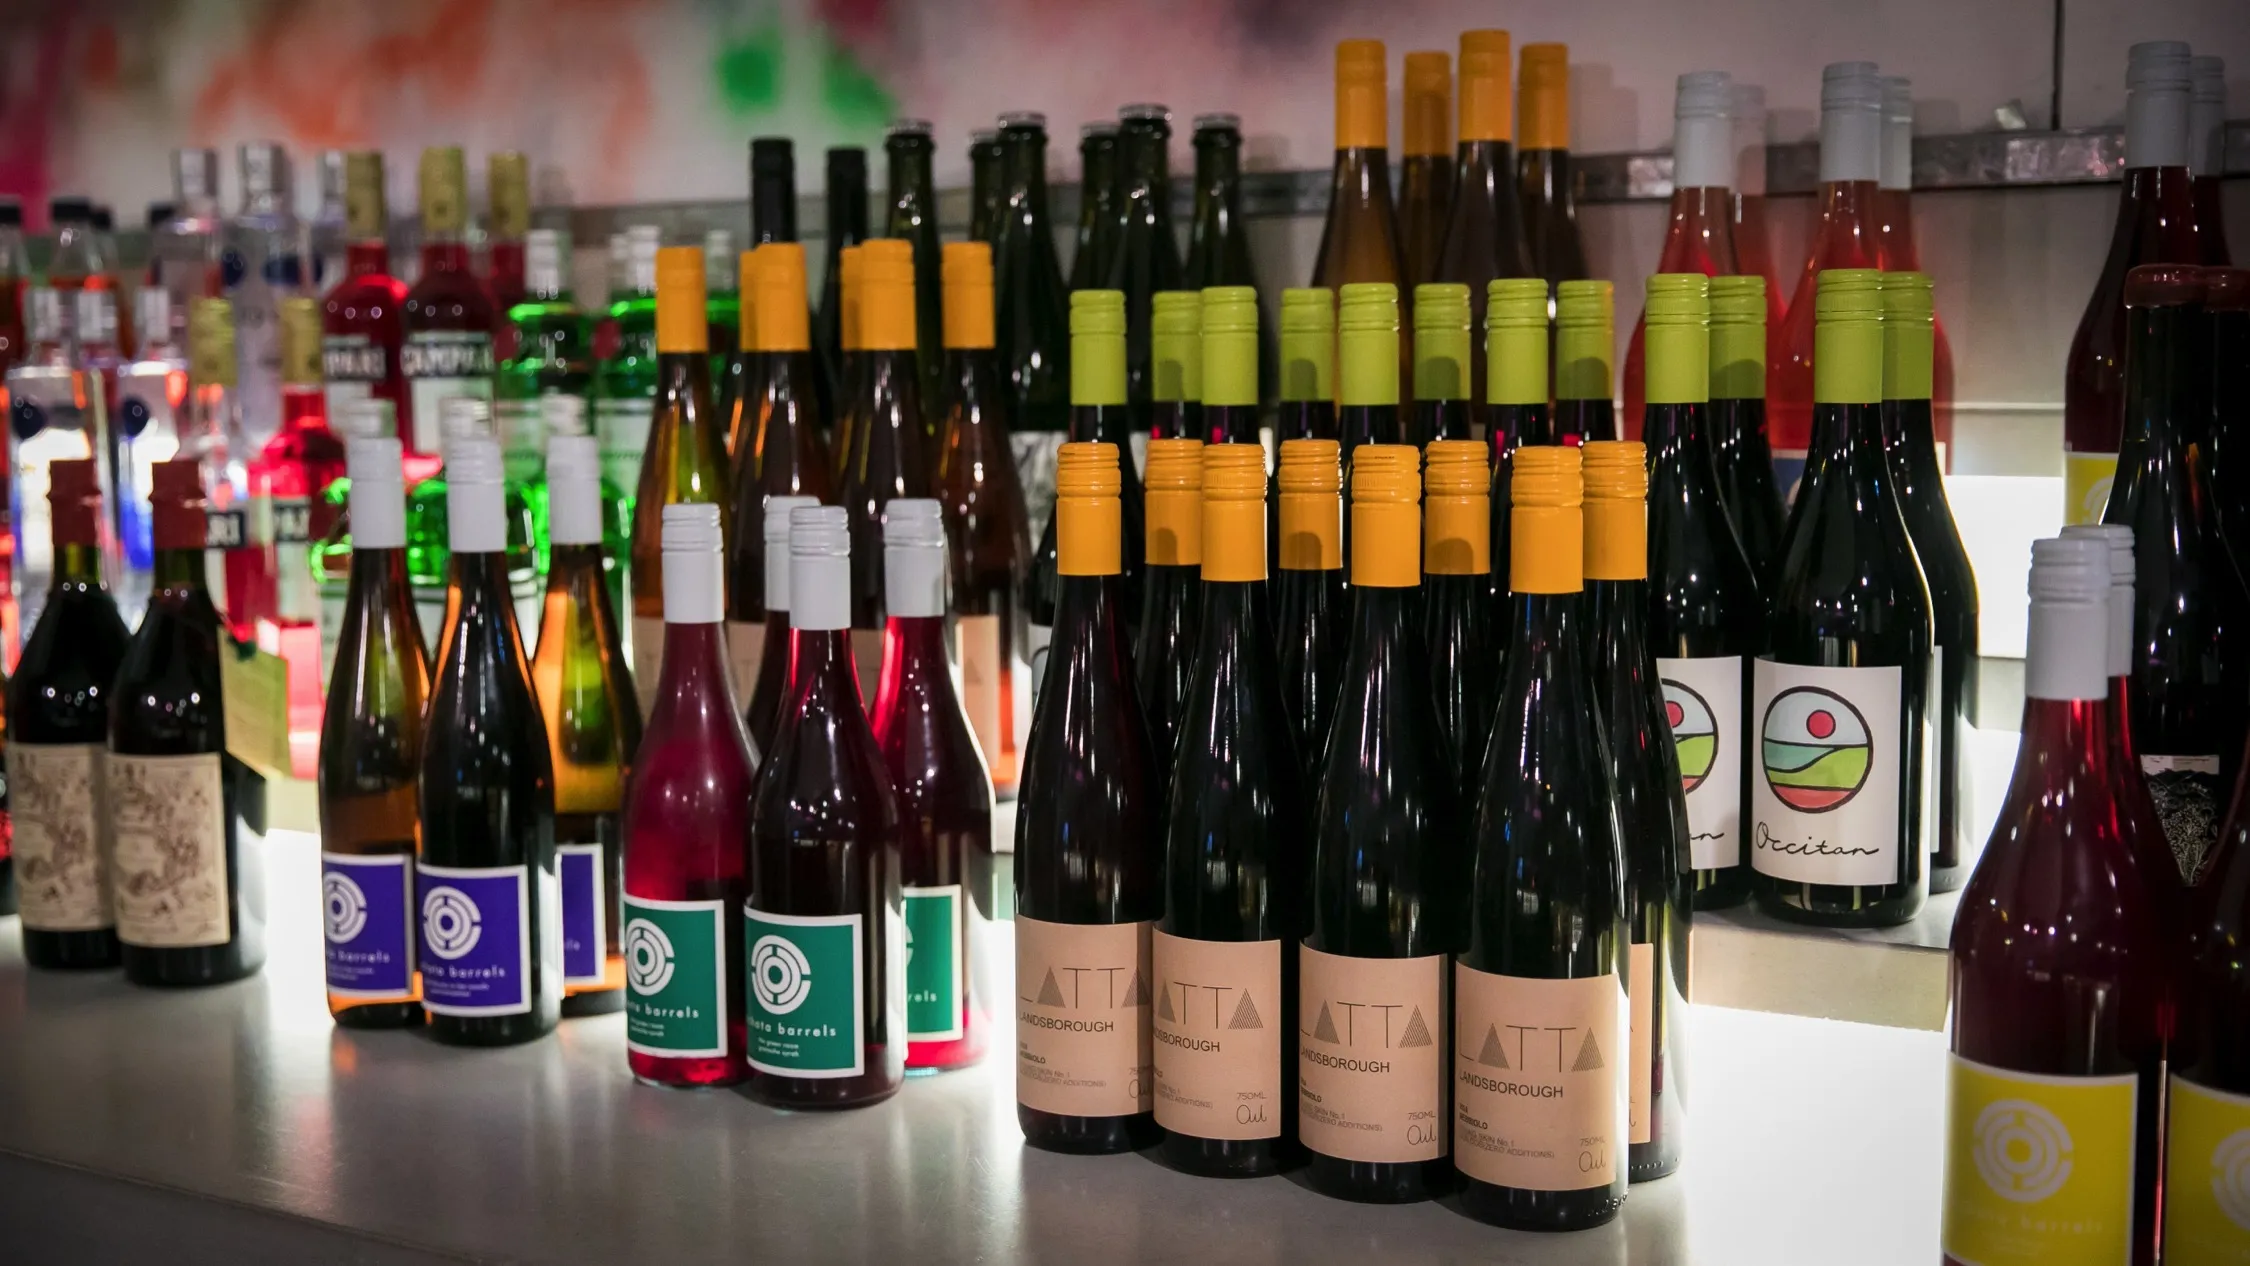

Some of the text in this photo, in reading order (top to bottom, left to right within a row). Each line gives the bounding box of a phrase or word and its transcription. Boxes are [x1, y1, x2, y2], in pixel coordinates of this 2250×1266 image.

[1756, 821, 1880, 856] Occitan
[449, 964, 506, 978] barrels
[907, 990, 937, 1003] rels
[1020, 965, 1151, 1009] ATTA
[645, 1002, 699, 1019] barrels
[1158, 979, 1264, 1030] ATTA
[778, 1021, 837, 1038] barrels
[1154, 1027, 1221, 1053] DSBOROUGH
[1459, 1012, 1605, 1073] LATTA
[1236, 1091, 1268, 1100] 750ML
[1460, 1071, 1564, 1099] LANDSBOROUGH
[1407, 1110, 1437, 1121] 750ML
